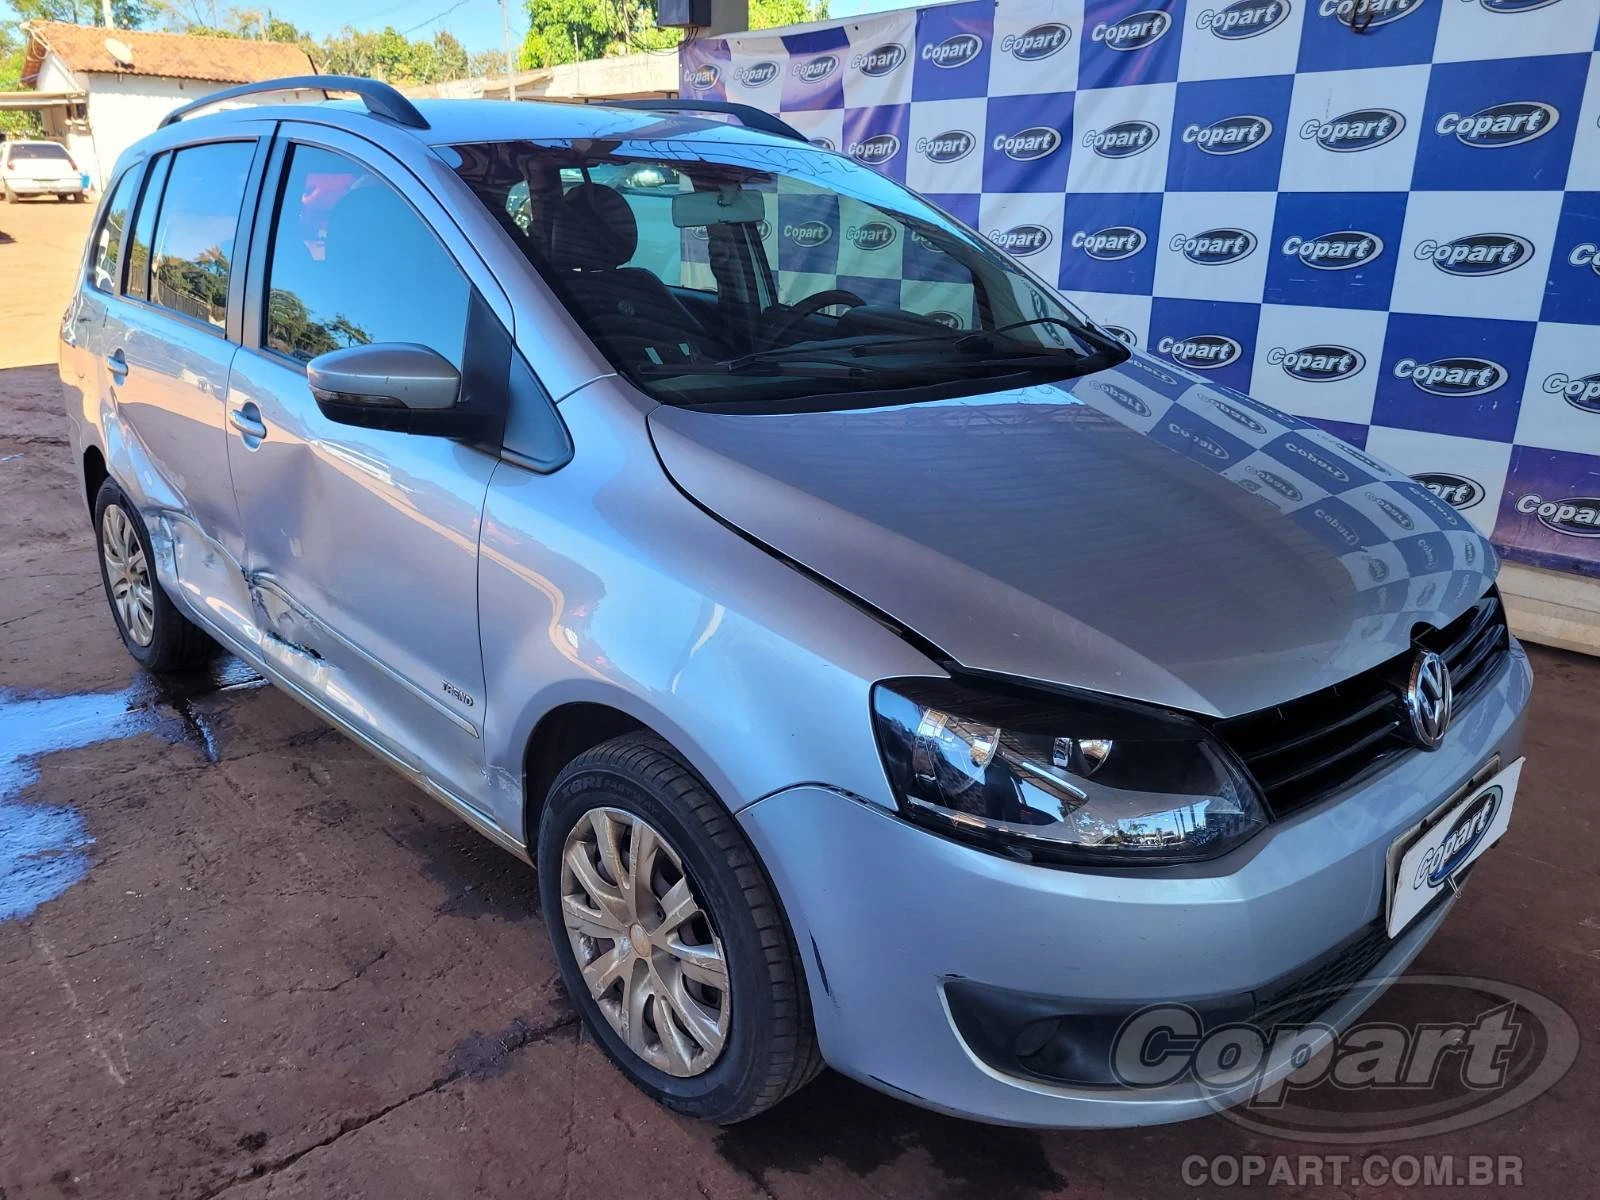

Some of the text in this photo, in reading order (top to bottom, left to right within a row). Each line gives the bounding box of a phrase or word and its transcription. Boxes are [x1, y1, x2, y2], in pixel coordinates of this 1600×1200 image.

[1091, 18, 1161, 42] Copart
[1196, 6, 1277, 31] Copart
[922, 42, 973, 60] Copart
[1001, 32, 1060, 54] Copart
[793, 60, 833, 78] Copart
[852, 50, 899, 70] Copart
[685, 70, 713, 82] Copart
[734, 65, 773, 81] Copart
[1300, 115, 1393, 143] Copart
[1436, 107, 1545, 139] Copart
[993, 134, 1053, 153] Copart
[1082, 129, 1149, 149] Copart
[1182, 123, 1262, 147] Copart
[849, 140, 894, 157] Copart
[916, 138, 967, 156] Copart
[784, 223, 824, 239] Copart
[847, 224, 889, 241] Copart
[988, 229, 1044, 248] Copart
[1070, 231, 1138, 251] Copart
[1169, 233, 1248, 256] Copart
[1282, 236, 1371, 259] Copart
[1414, 239, 1518, 266] Copart
[1157, 337, 1232, 360] Copart
[1267, 347, 1353, 373] Copart
[1393, 358, 1494, 387] Copart
[1543, 373, 1600, 401] Cop
[1515, 494, 1600, 525] Copa
[441, 680, 474, 706] TREND
[1414, 793, 1493, 889] Copart
